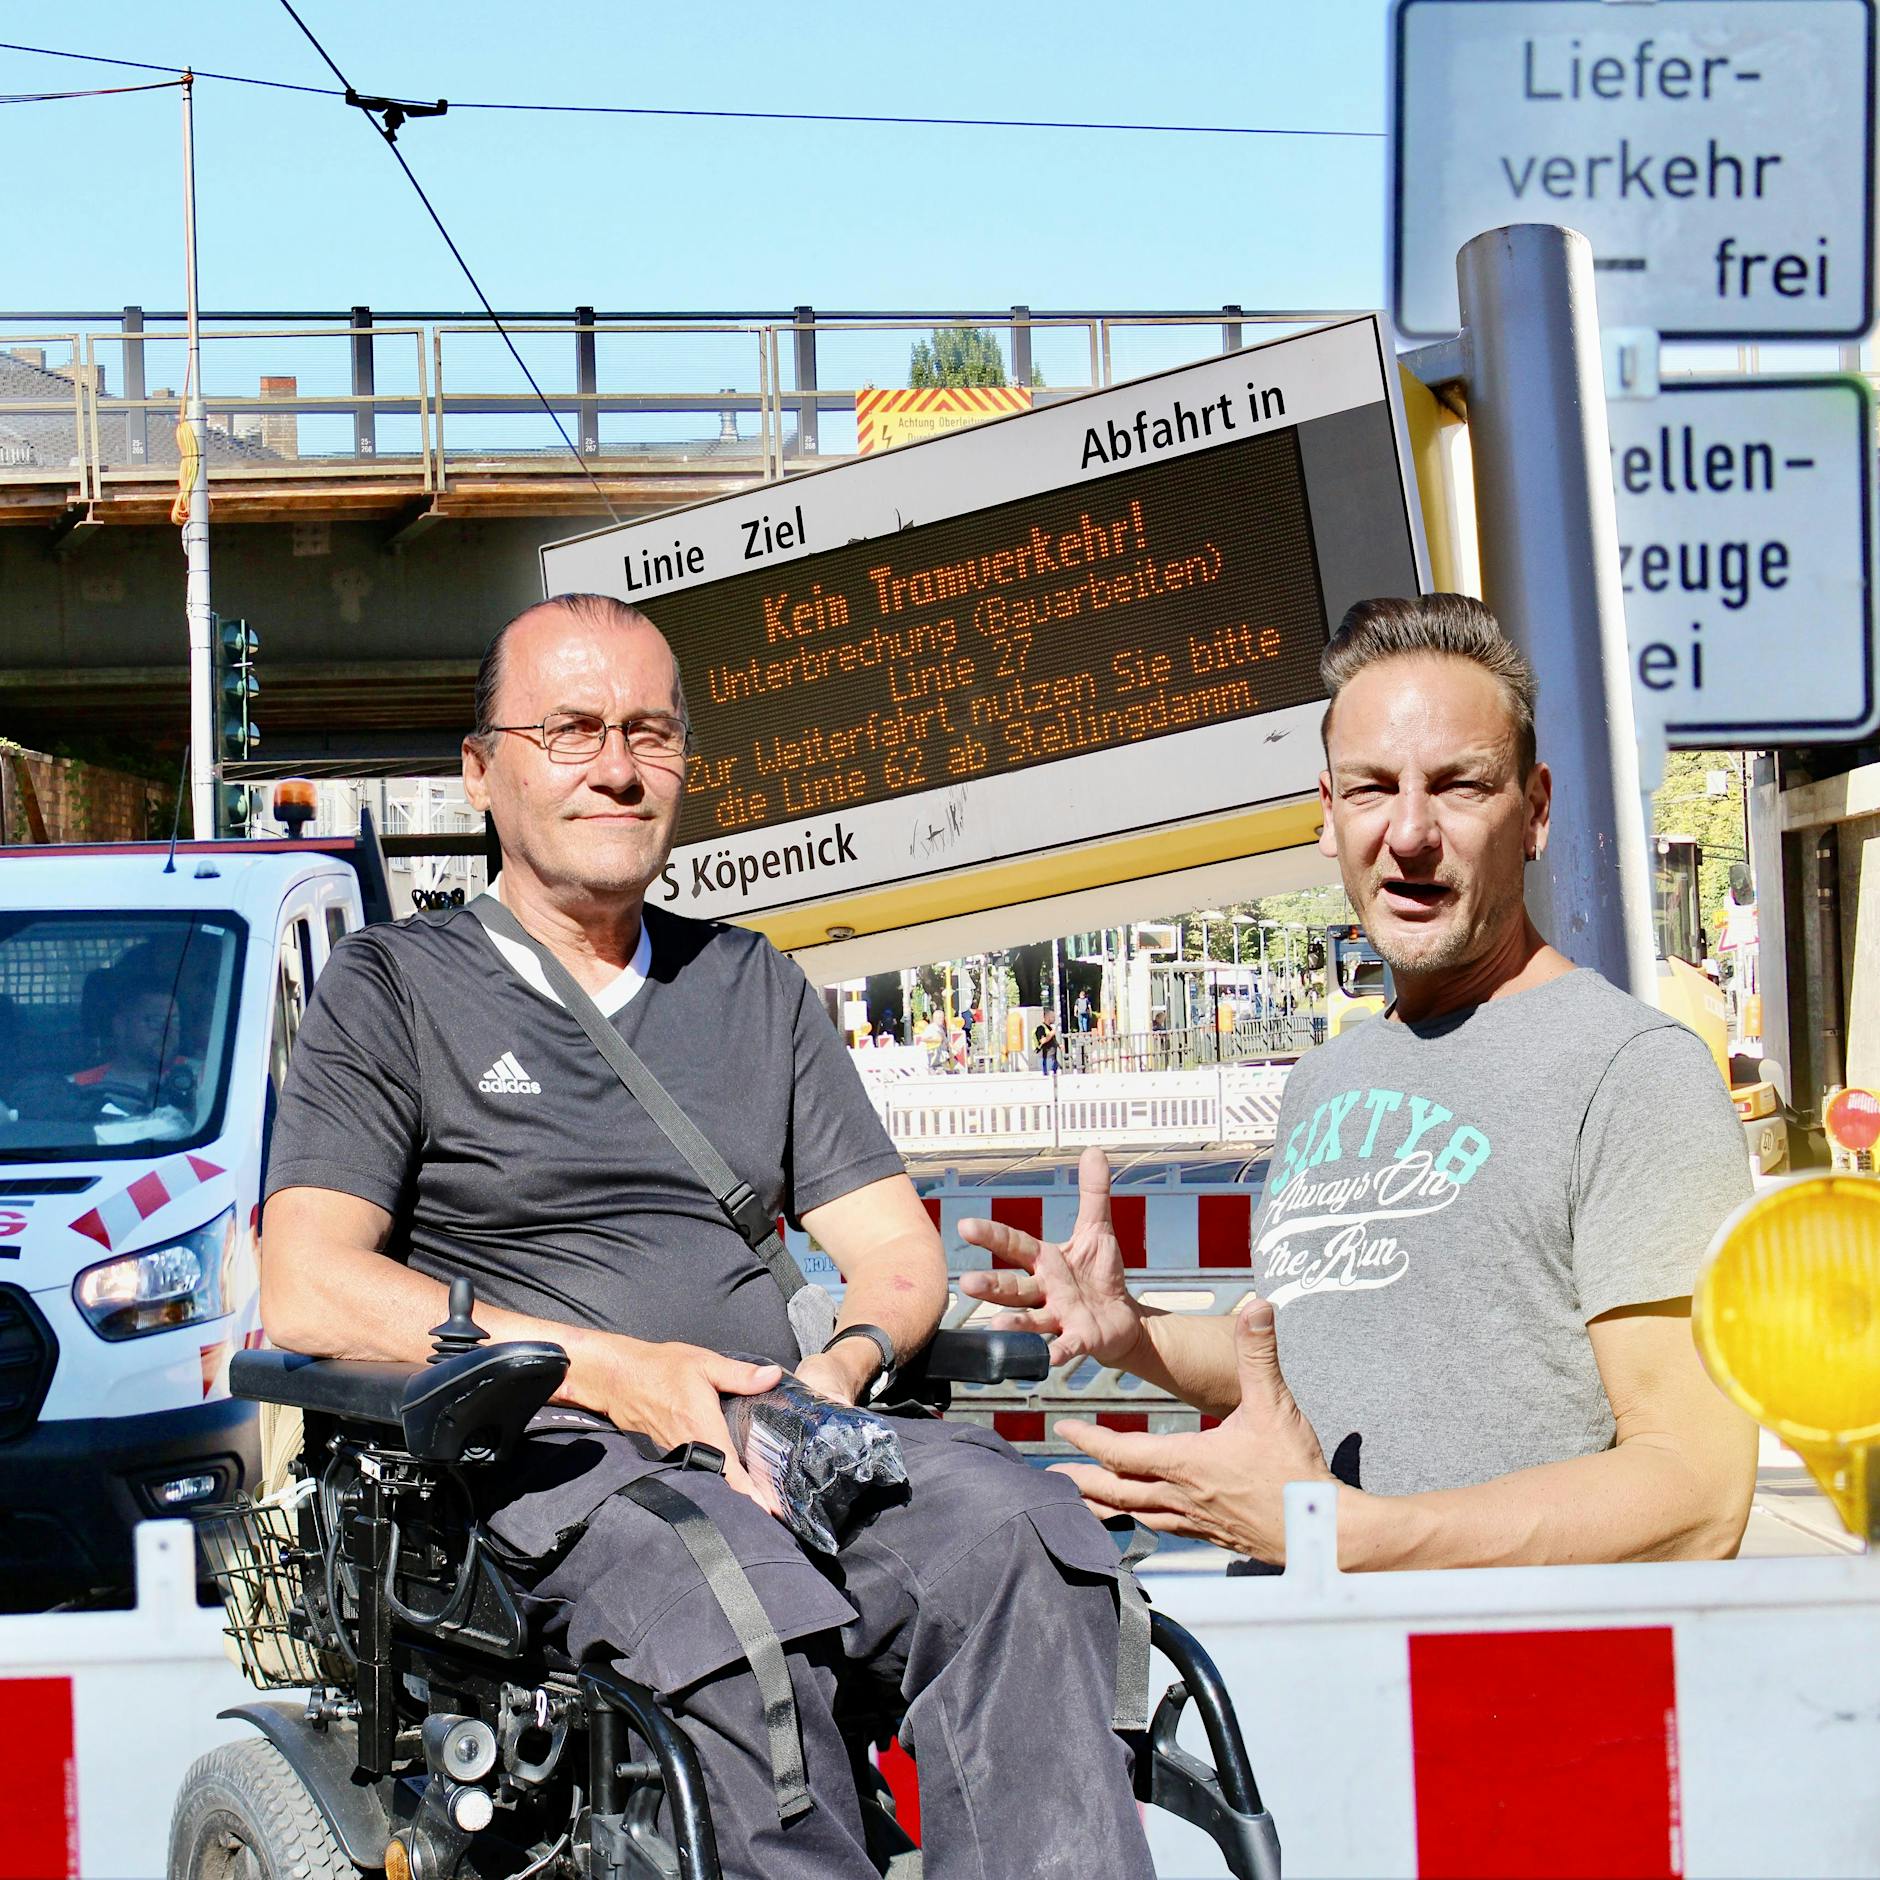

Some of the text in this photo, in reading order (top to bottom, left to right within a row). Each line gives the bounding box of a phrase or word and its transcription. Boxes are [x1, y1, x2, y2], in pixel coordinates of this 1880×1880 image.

[1524, 38, 1762, 101] Liefer-
[1501, 139, 1783, 200] verkehr
[1715, 237, 1830, 298] frei
[898, 416, 985, 430] Achtung Oberleitun
[1081, 382, 1286, 469] Abfahrt in
[1612, 425, 1815, 494] ellen-
[624, 505, 806, 591] Linie Ziel
[763, 500, 1147, 644] Kein Tramverkehr!
[710, 542, 1222, 703] Unterbrechung (Bauarbeiten)
[1636, 623, 1706, 691] ei
[889, 632, 1033, 702] Linie 27
[686, 624, 1281, 793] Zur Weiterfahrt nutzen Sie bitte
[715, 680, 1258, 827] die Linie 62 ab Stellingdamm.
[660, 823, 858, 901] S Köpenick
[478, 1079, 542, 1095] adidas
[1259, 1151, 1455, 1226] Always On
[1302, 1222, 1398, 1288] Run
